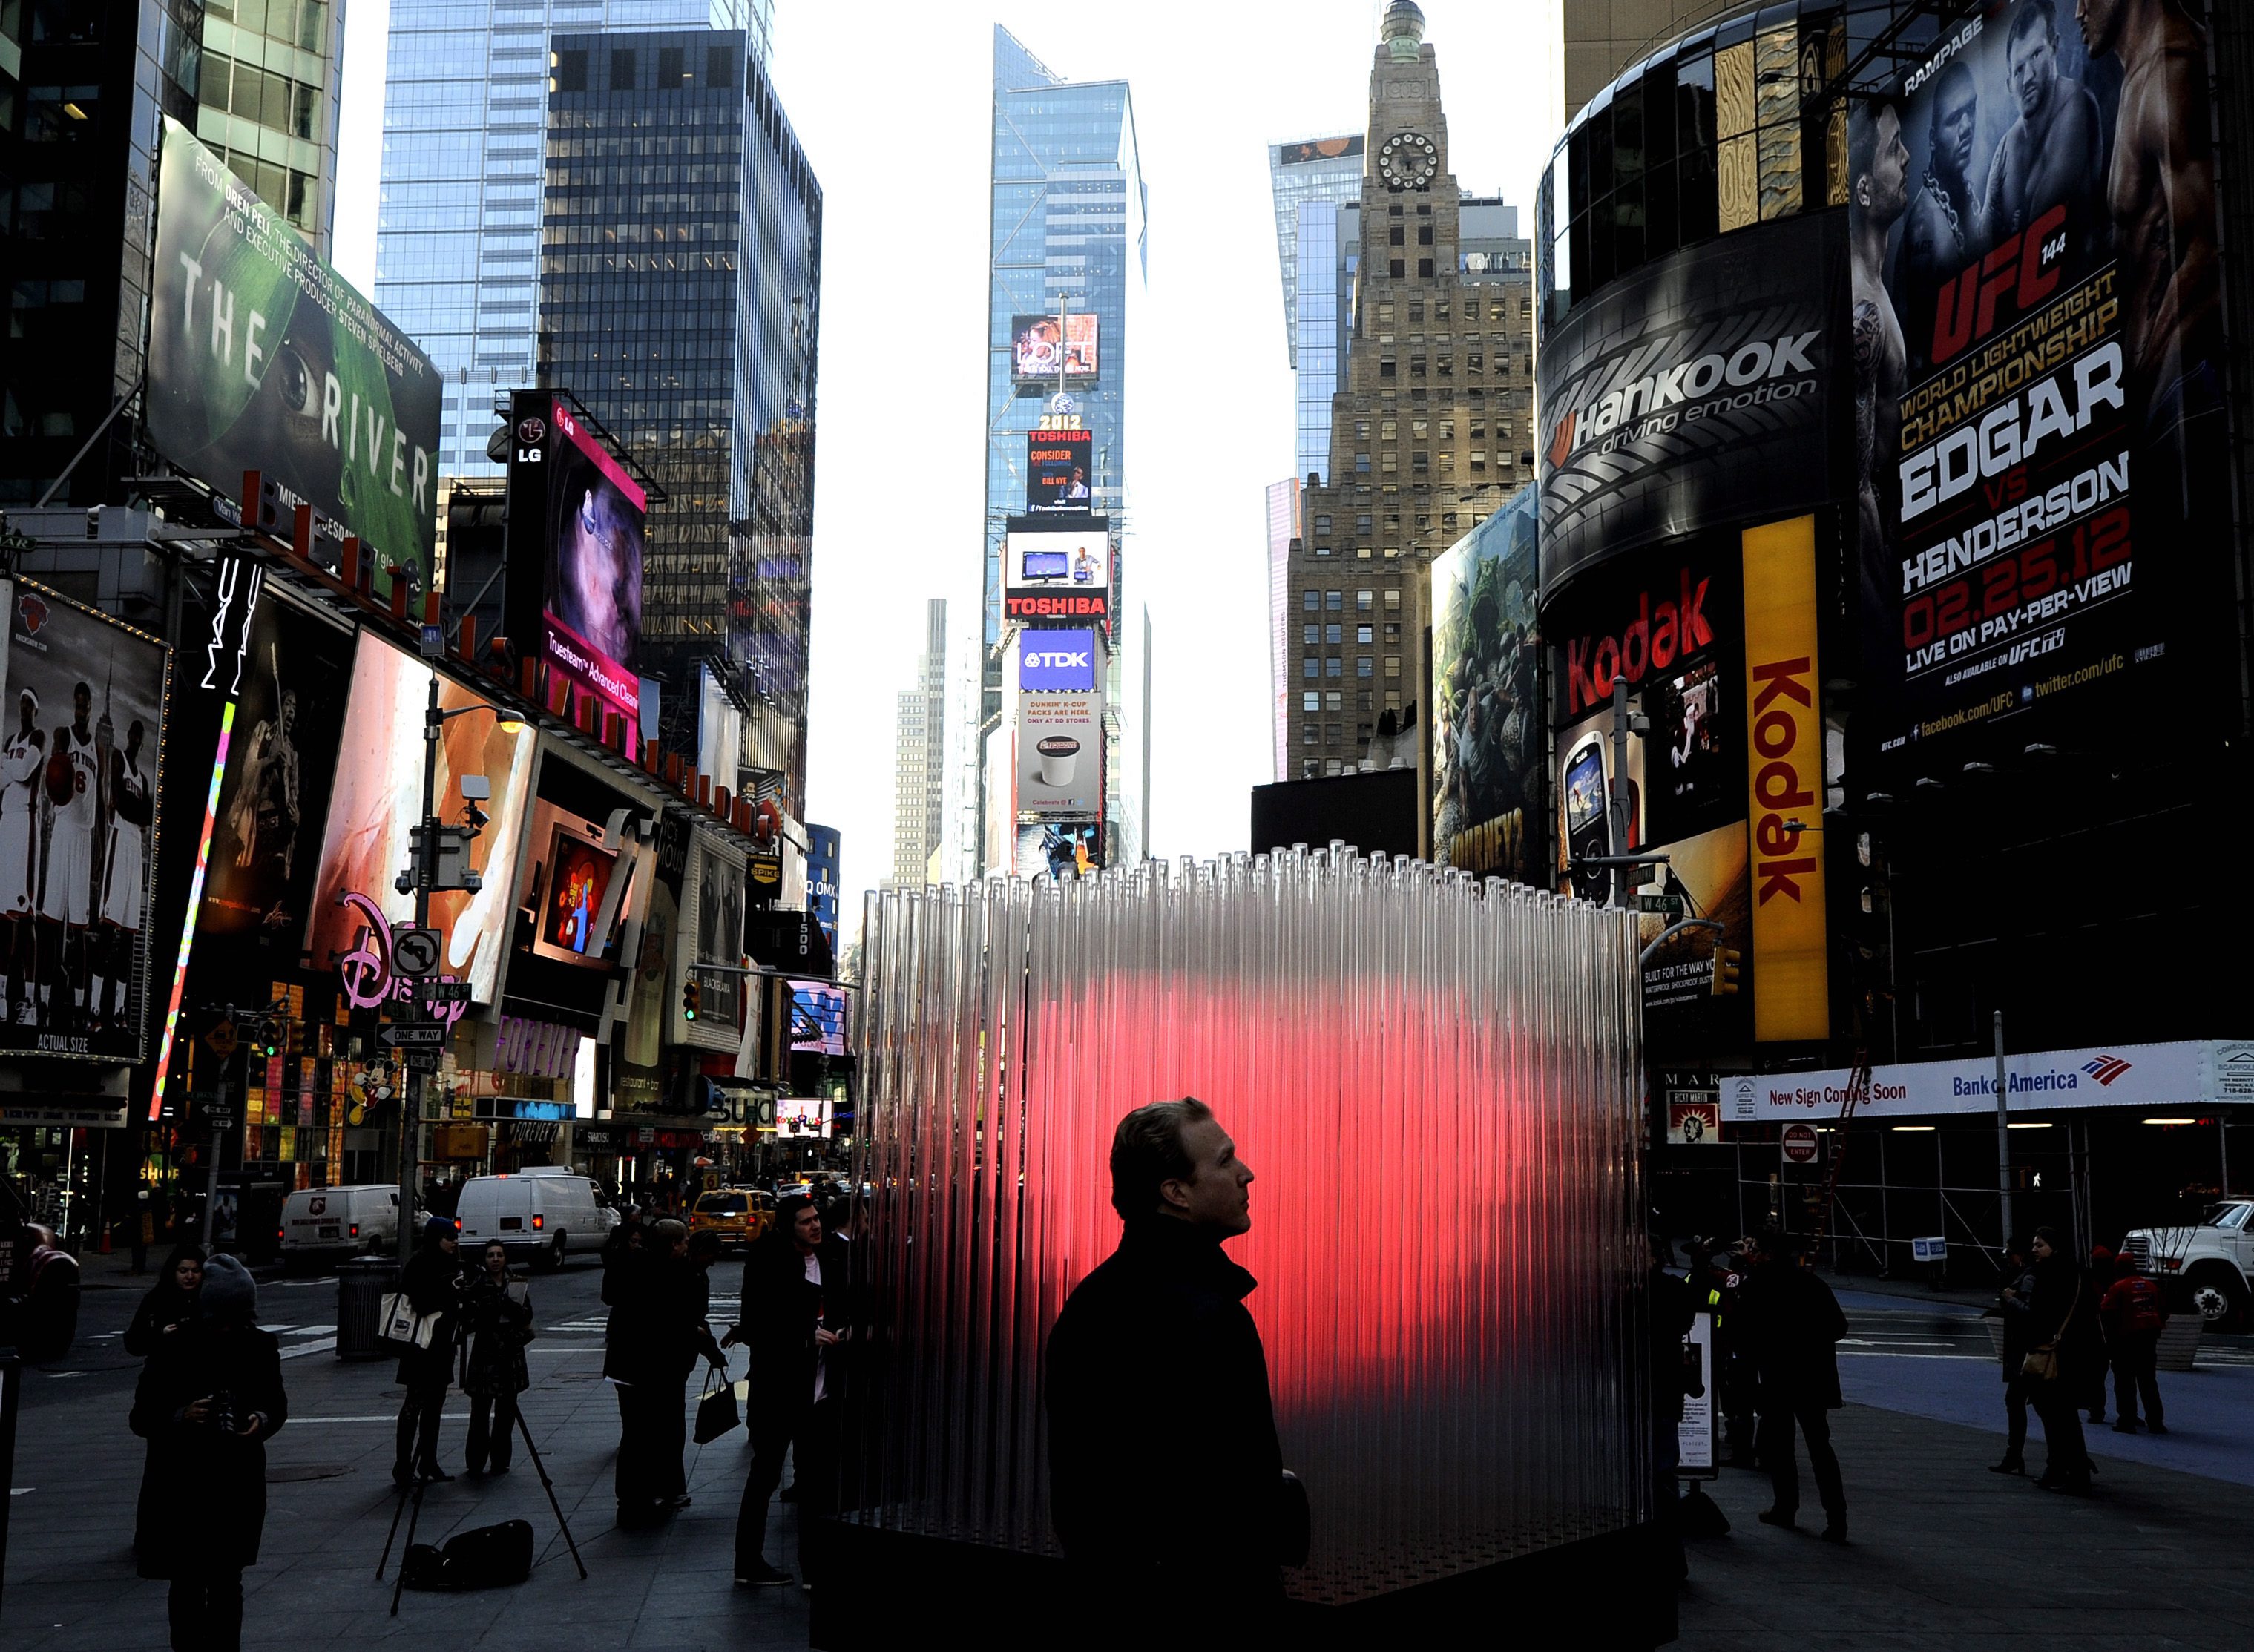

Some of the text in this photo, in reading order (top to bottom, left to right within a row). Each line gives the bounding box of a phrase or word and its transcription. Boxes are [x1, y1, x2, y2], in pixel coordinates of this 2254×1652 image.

[1905, 14, 1983, 96] RAMPAGE
[2042, 232, 2066, 266] 144
[195, 156, 424, 378] FROM OREN PELI, THE DIRECTOR OF PARANORMAL ACTIVITY,
[224, 206, 404, 378] AND EXECUTIVE PRODUCER STEVEN SPIELBERG
[1931, 203, 2066, 364] UFC
[180, 251, 266, 390] THE
[1017, 341, 1093, 363] LOFT
[1899, 269, 2116, 421] WORLD LIGHTWEIGHT
[1901, 297, 2118, 451] CHAMPIONSHIP
[565, 420, 574, 436] LG
[1039, 415, 1081, 430] 2012
[1601, 378, 1818, 455] driving emotion
[322, 371, 429, 516] RIVER
[1029, 430, 1091, 442] TOSHIBA
[1899, 342, 2125, 524] EDGAR
[519, 449, 542, 462] LG
[1031, 450, 1071, 460] CONSIDER
[1042, 477, 1067, 485] BILL NYE
[1984, 464, 2028, 510] VS
[1902, 450, 2129, 594] HENDERSON
[1904, 507, 2132, 650] 02.25.12
[1007, 598, 1105, 615] TOSHIBA
[1906, 562, 2132, 673] LIVE ON PAY-PER-VIEW
[1568, 564, 1715, 717] Kodak
[1039, 652, 1088, 667] TDK
[1945, 655, 2008, 686] ALSO AVAILABLE ON
[588, 662, 619, 696] Advanced
[2035, 654, 2124, 698] twitter.com/ufc
[1921, 691, 2014, 738] facebook.com/UFC
[75, 770, 86, 794] 6
[1752, 656, 1817, 907] Kodak
[751, 868, 780, 878] SPIKE
[816, 881, 835, 895] OMX
[1644, 898, 1654, 912] W
[1655, 898, 1668, 912] 46
[799, 913, 809, 955] 1500
[1645, 958, 1715, 984] BUILT FOR THE WAY YO
[438, 985, 445, 998] W
[448, 985, 459, 998] 46
[38, 1034, 88, 1053] ACTUAL SIZE
[395, 1030, 438, 1040] ONE WAY
[493, 1015, 582, 1079] FOREVER
[620, 1075, 646, 1088] restaurant
[651, 1080, 659, 1090] bar
[1770, 1090, 1793, 1105] New
[1795, 1087, 1821, 1108] Sign
[1873, 1083, 1907, 1101] Soon
[1953, 1075, 1991, 1097] Bank
[2009, 1068, 2078, 1093] America
[1674, 1093, 1689, 1103] RICKY
[513, 1122, 551, 1143] FOREVER
[707, 1175, 714, 1187] 6
